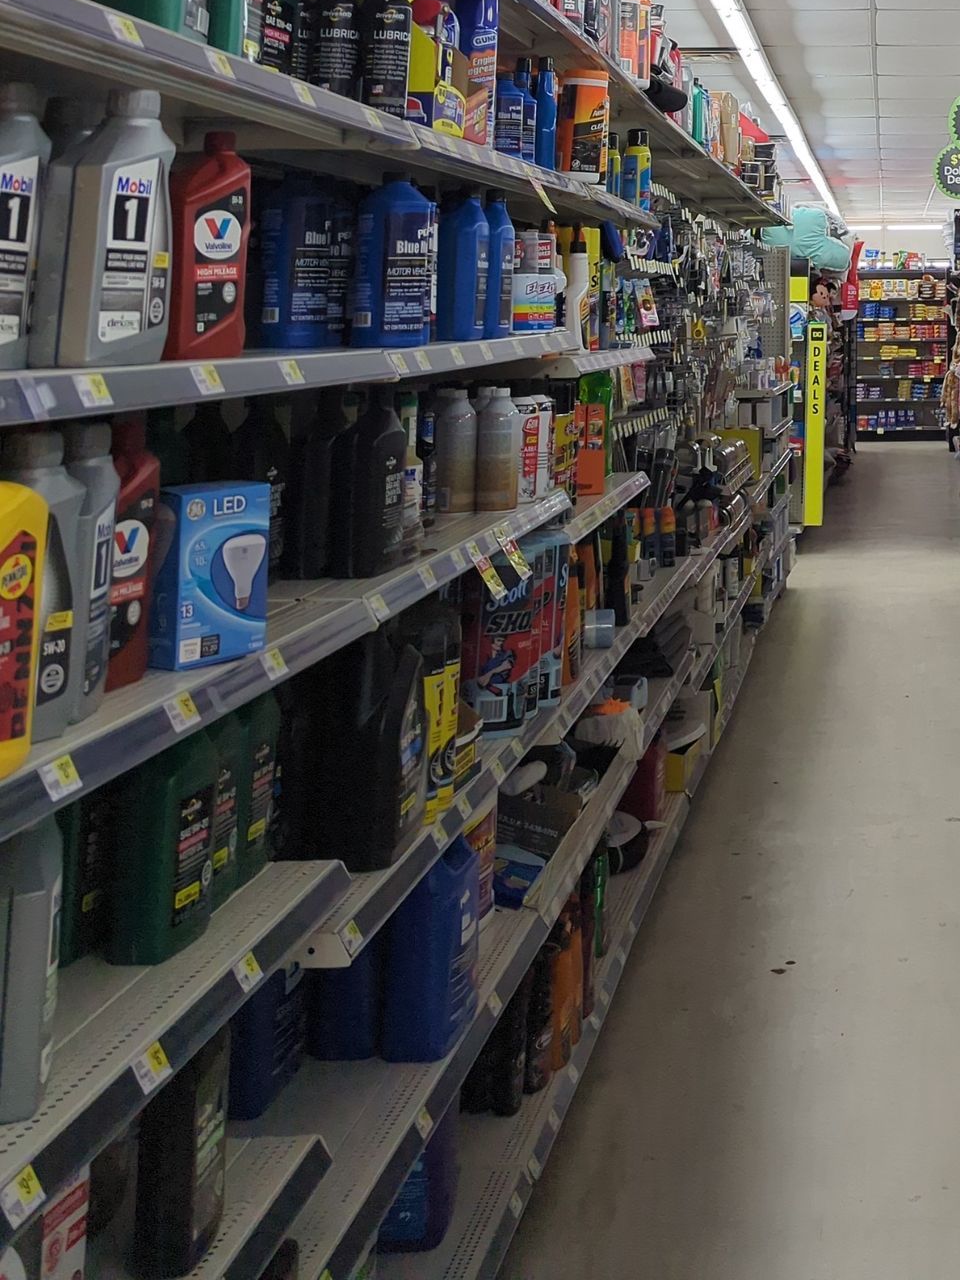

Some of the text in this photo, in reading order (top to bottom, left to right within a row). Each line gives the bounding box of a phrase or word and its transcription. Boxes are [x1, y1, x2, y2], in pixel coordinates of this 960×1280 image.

[1, 173, 34, 192] Mobil
[116, 176, 153, 195] Mobil
[8, 196, 21, 240] 1
[124, 198, 139, 240] 1
[204, 241, 233, 252] Valvoline
[395, 239, 420, 255] Blue
[196, 268, 213, 278] HIGH
[812, 346, 821, 415] DEALS
[213, 495, 246, 517] LED
[180, 604, 194, 619] 13
